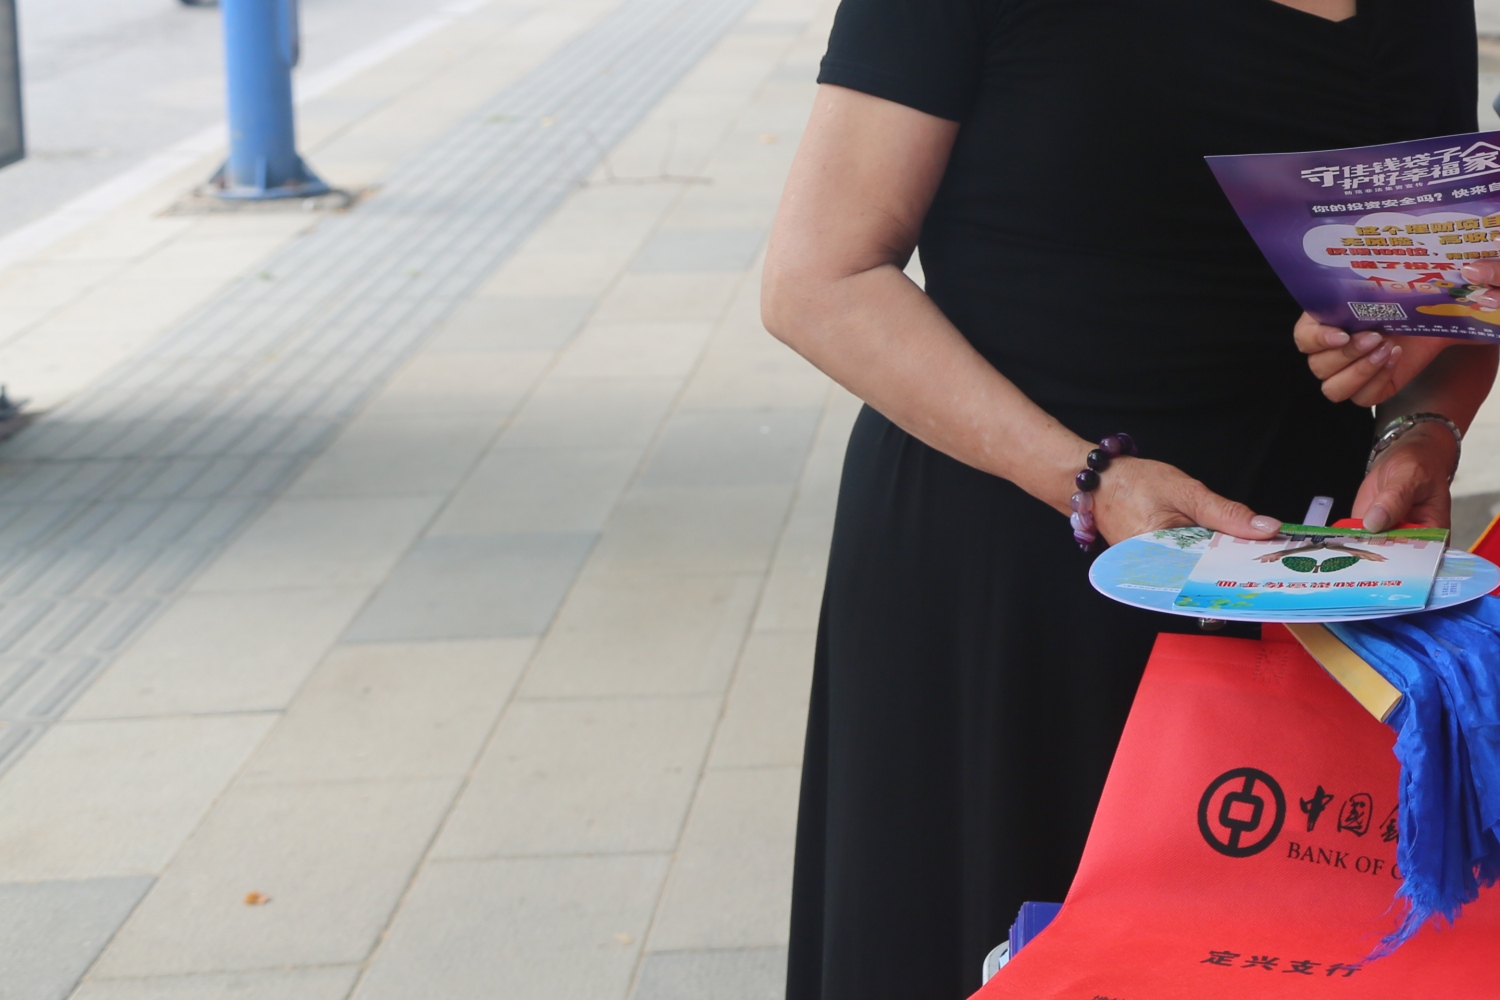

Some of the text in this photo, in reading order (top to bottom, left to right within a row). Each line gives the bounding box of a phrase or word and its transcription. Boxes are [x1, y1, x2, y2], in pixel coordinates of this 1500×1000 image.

[1301, 146, 1462, 188] 守住钱袋子
[1350, 260, 1471, 272] 晚了投不
[1287, 841, 1349, 870] BANK
[1355, 855, 1385, 876] OF
[1201, 950, 1362, 978] 定兴支行
